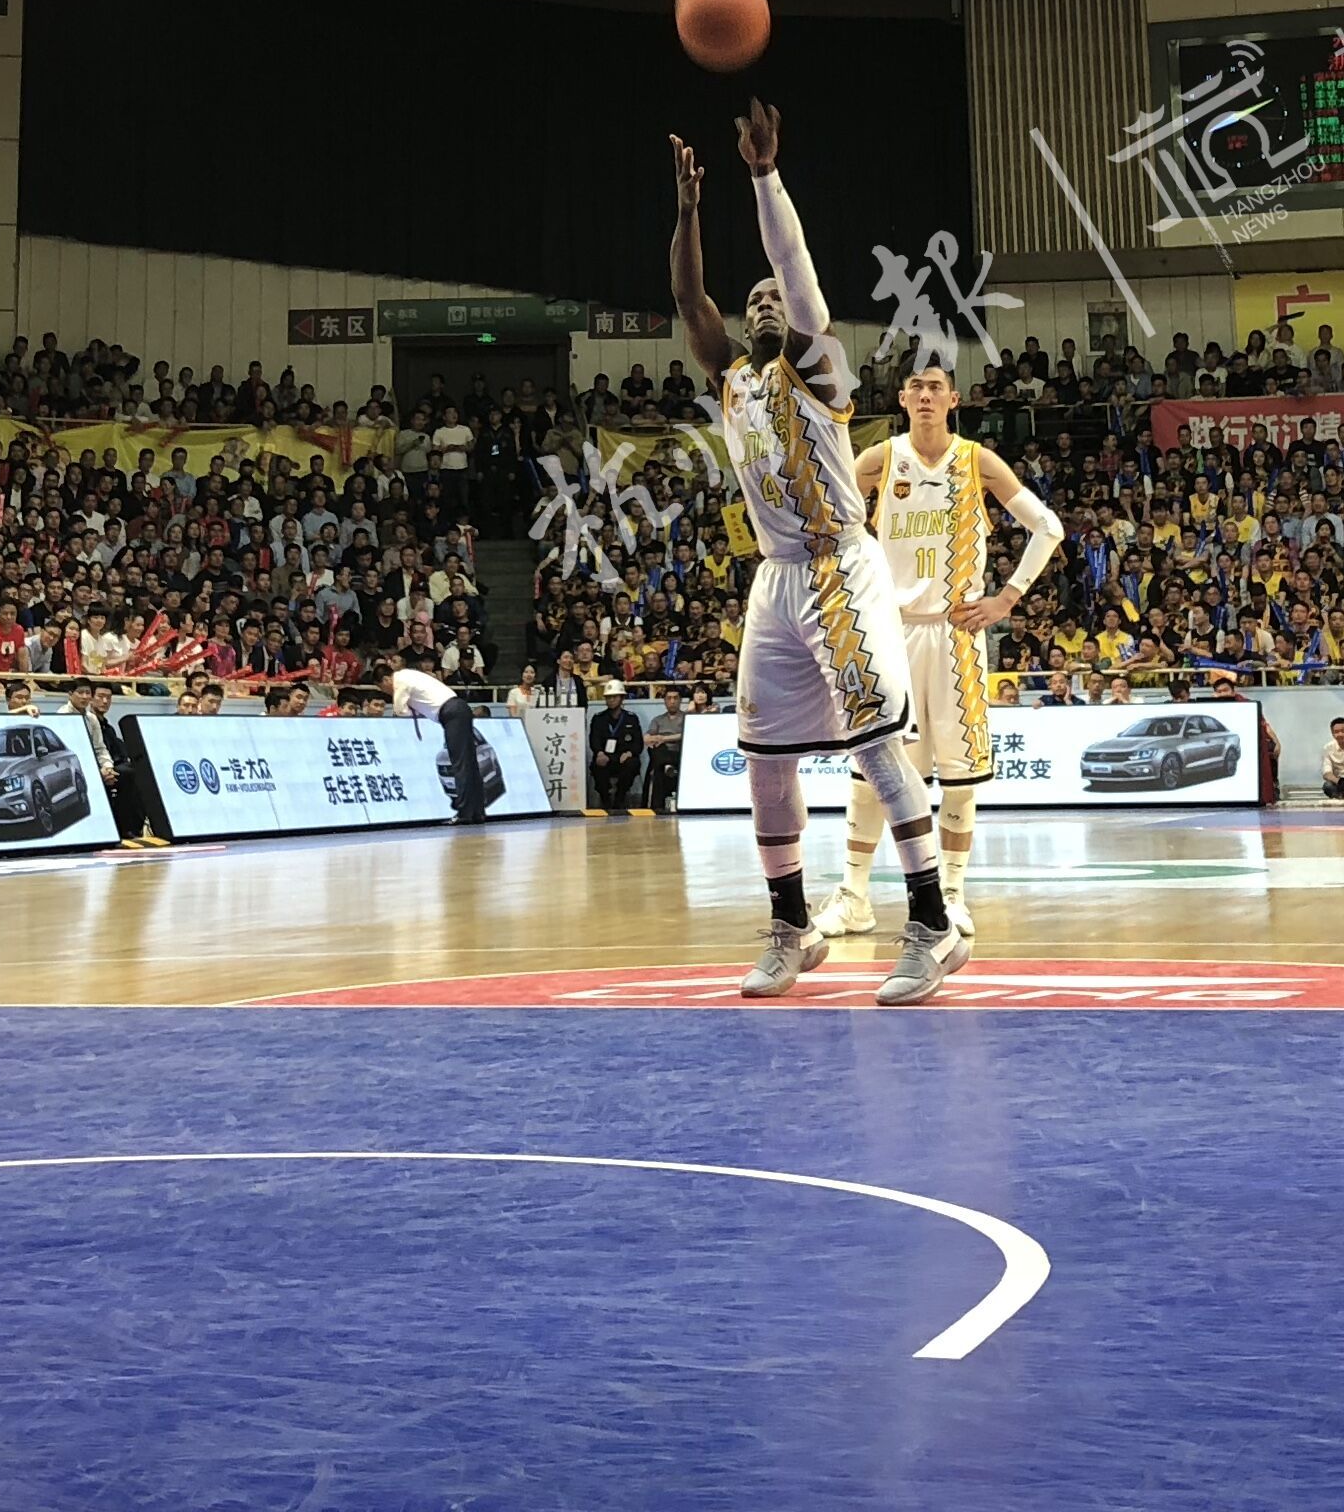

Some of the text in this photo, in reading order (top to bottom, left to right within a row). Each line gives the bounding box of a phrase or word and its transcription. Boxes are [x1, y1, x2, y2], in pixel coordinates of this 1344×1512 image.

[319, 314, 367, 338] 东区
[594, 312, 642, 334] 南区
[761, 472, 784, 509] 4
[889, 509, 961, 540] LIONS
[915, 548, 936, 579] 11
[327, 737, 382, 768] 全新宝来
